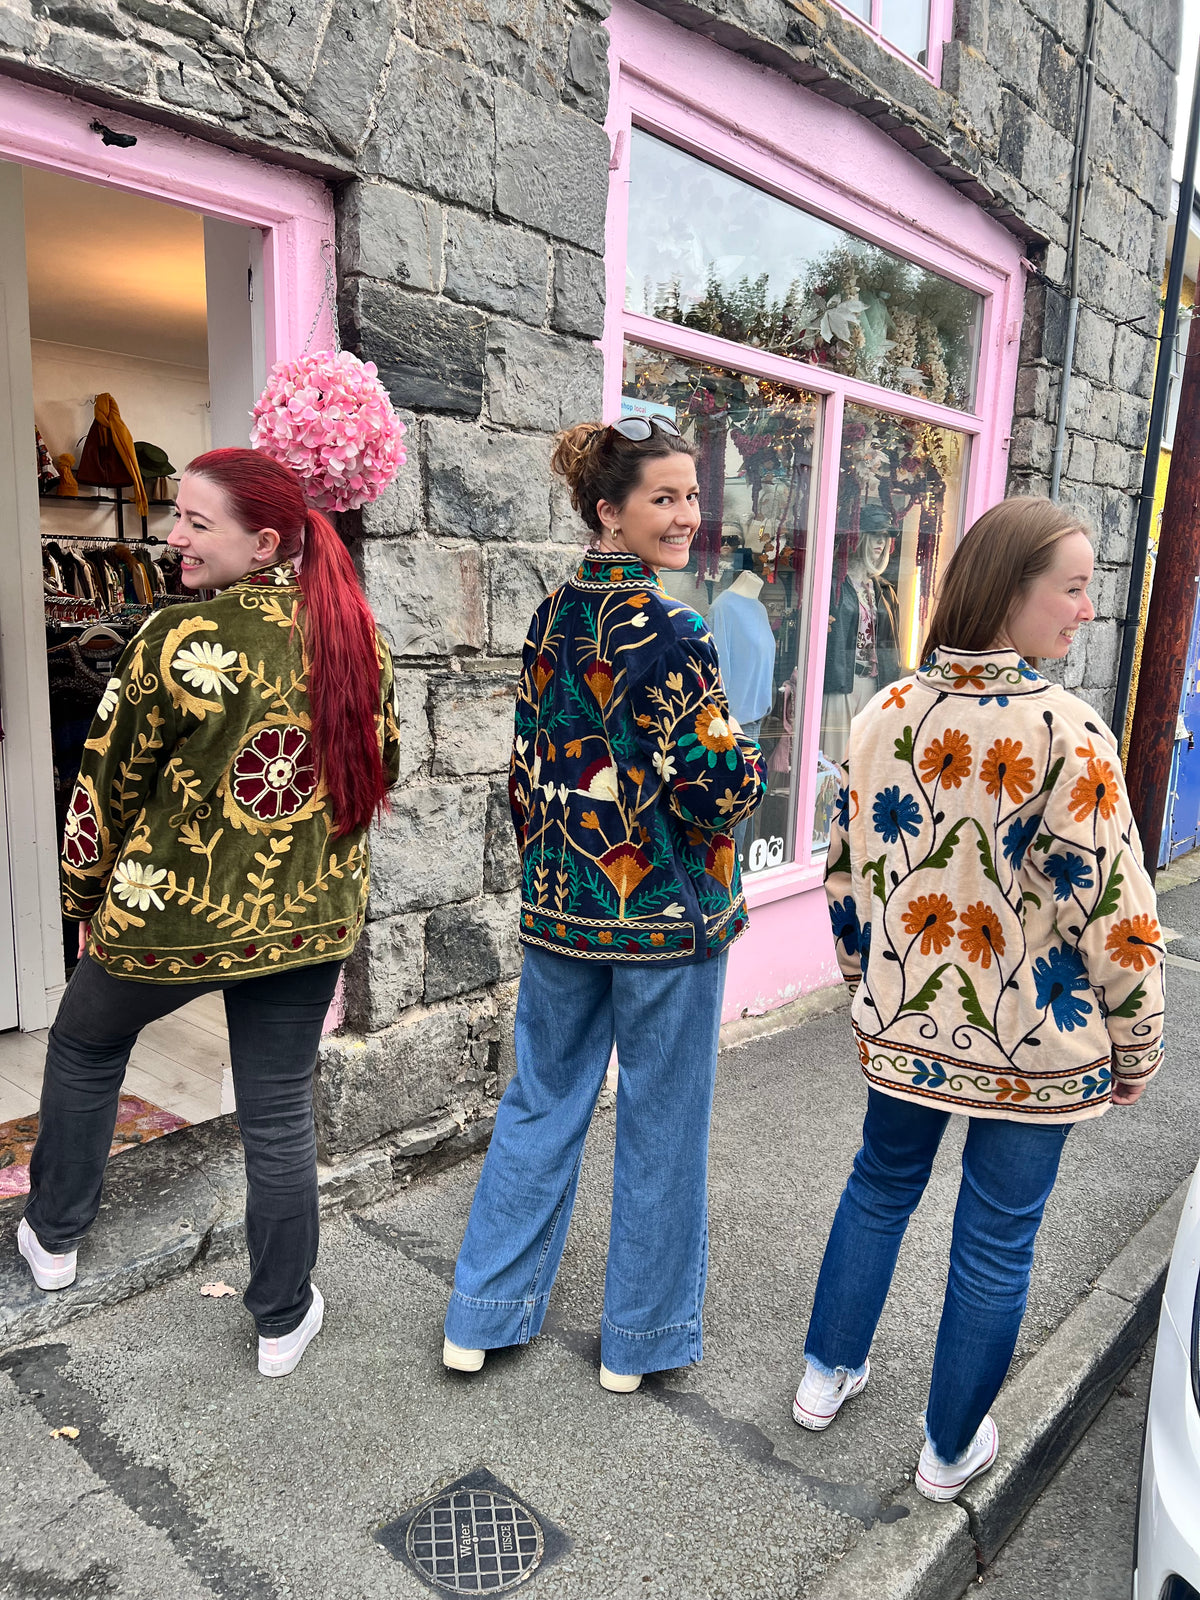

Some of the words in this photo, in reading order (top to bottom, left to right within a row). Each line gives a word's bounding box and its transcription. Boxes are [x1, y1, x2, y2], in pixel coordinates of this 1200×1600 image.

[634, 404, 647, 413] local
[459, 1523, 472, 1558] Water
[501, 1525, 513, 1552] UISCE
